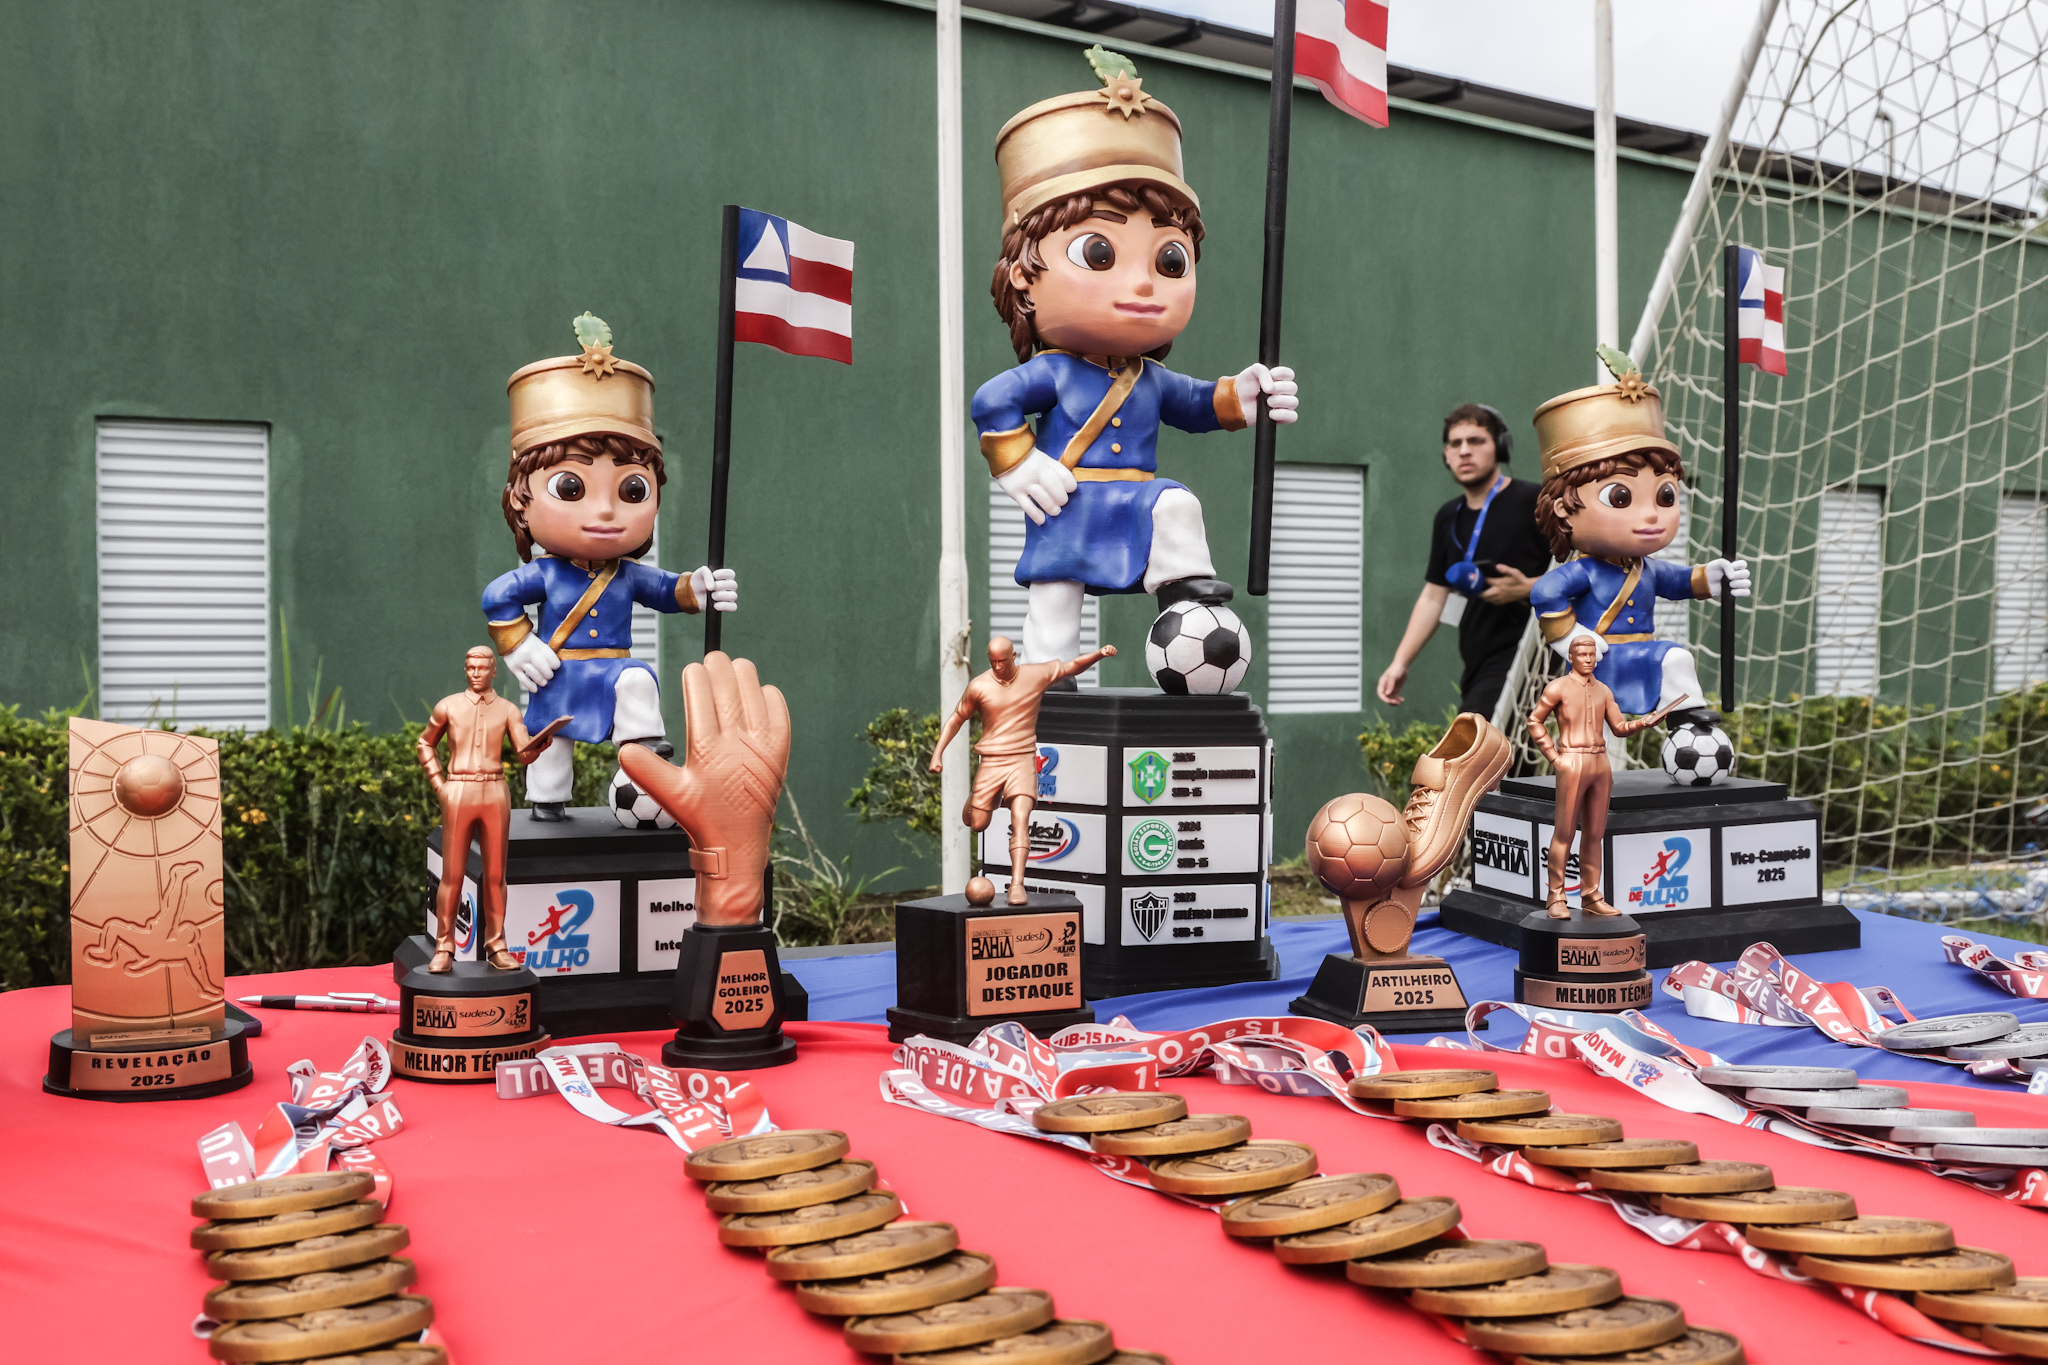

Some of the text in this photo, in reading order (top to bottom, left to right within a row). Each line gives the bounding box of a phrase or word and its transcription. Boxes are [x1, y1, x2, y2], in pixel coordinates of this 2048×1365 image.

[1658, 837, 1691, 889] 2
[1757, 868, 1786, 883] 2025
[1628, 887, 1689, 906] DE JULHO
[547, 889, 595, 949] 2
[524, 948, 590, 969] JULHO
[720, 972, 767, 985] MELHOR
[985, 962, 1068, 982] JOGADOR
[1371, 973, 1452, 988] ARTILHEIRO
[718, 985, 770, 998] GOLEIRO
[982, 982, 1074, 1003] DESTAQUE
[1393, 990, 1434, 1005] 2025
[1555, 986, 1617, 1005] MELHOR
[724, 998, 764, 1014] 2025
[91, 1050, 211, 1069] REVELAÇÃO
[404, 1051, 467, 1074] MELHOR
[131, 1074, 175, 1087] 2025
[332, 1100, 404, 1145] COPA
